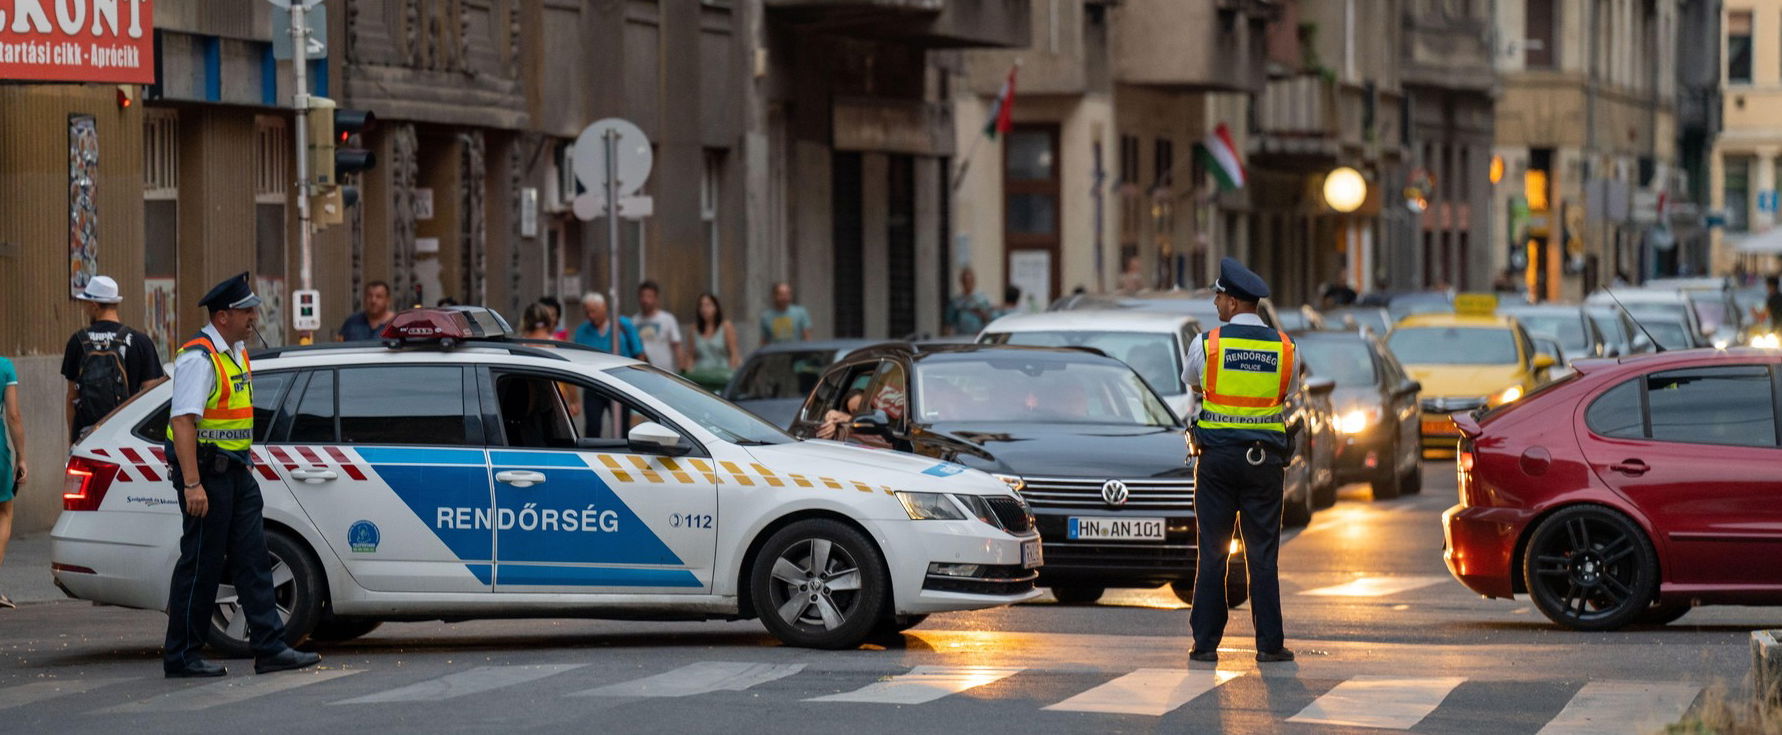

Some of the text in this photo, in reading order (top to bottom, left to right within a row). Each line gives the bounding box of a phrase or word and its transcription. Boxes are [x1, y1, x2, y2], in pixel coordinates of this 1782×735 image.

[53, 42, 82, 66] cikk
[90, 43, 140, 69] Aprócikk
[1240, 363, 1261, 371] POLICE
[1205, 412, 1233, 423] OLICE
[437, 503, 619, 533] RENDŐRSÉG
[685, 514, 713, 530] 112
[1079, 521, 1163, 538] HN AN 101
